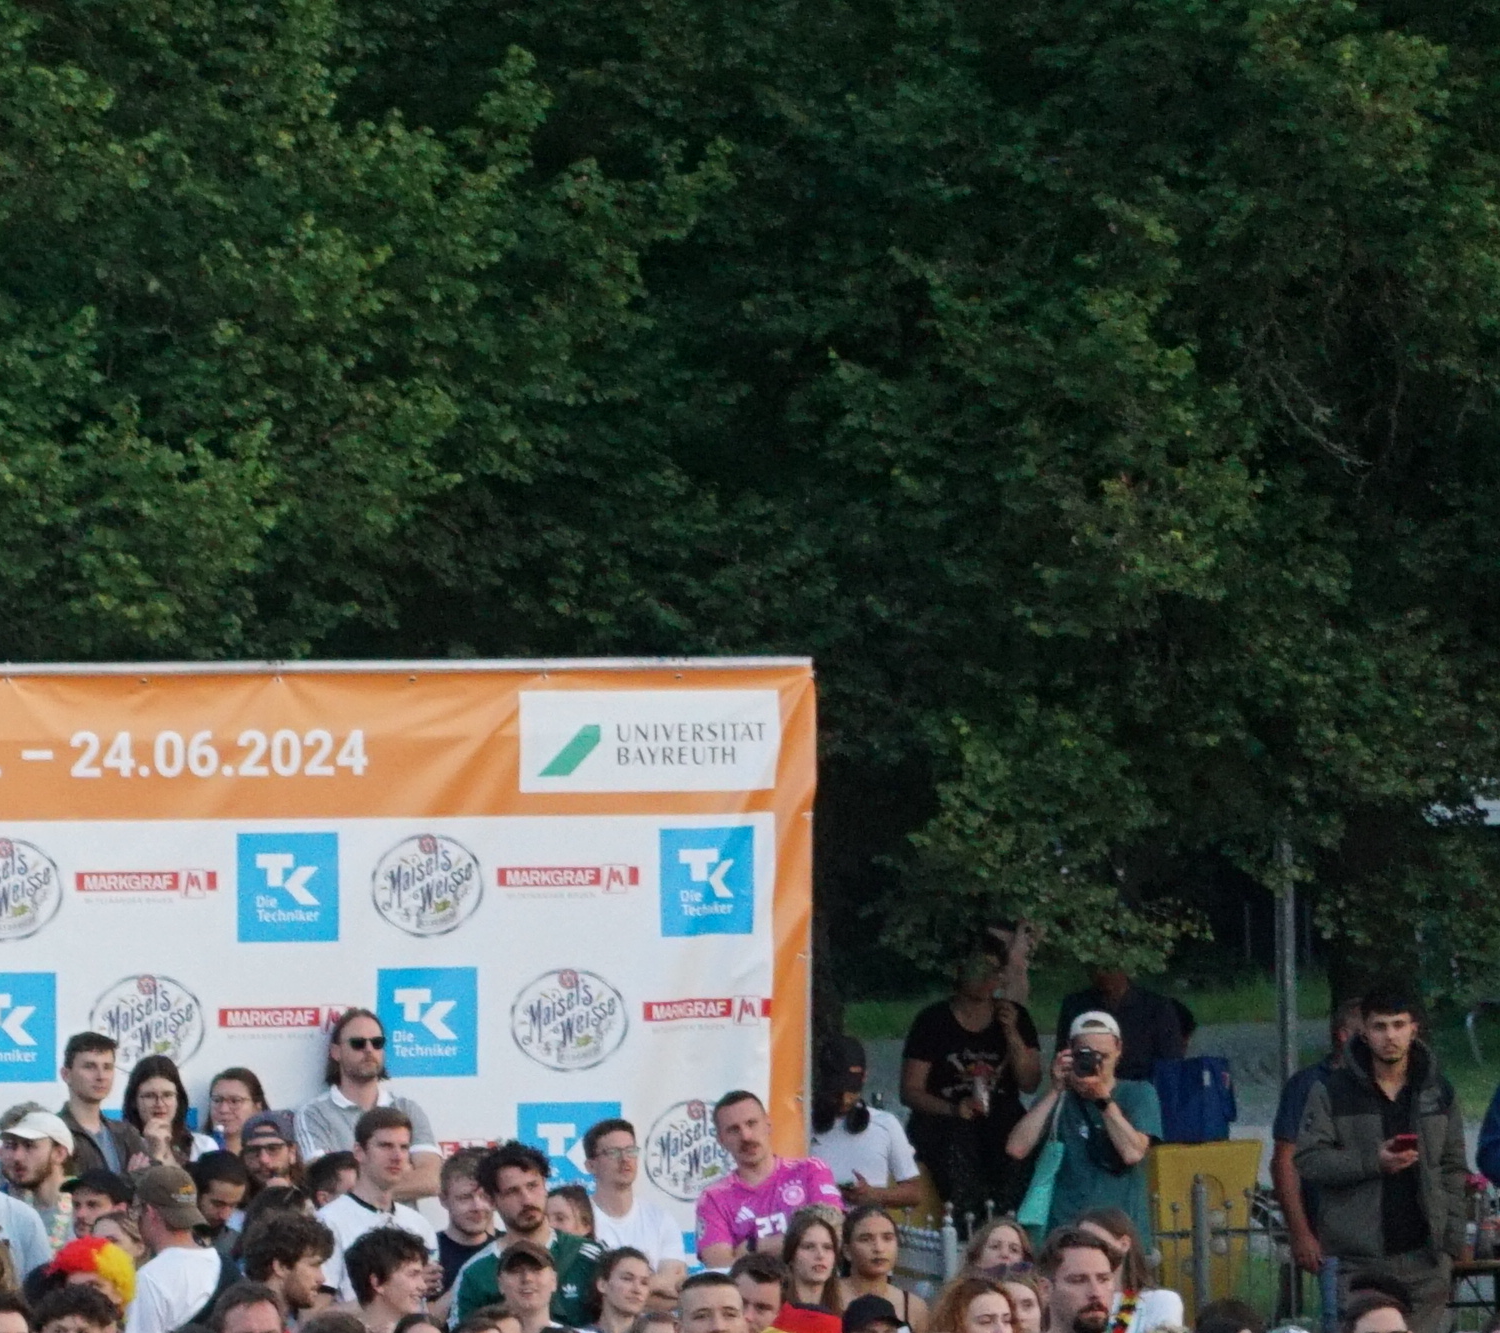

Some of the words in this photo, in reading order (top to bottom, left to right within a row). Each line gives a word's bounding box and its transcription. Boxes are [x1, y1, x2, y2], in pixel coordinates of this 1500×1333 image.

[616, 721, 767, 744] UNIVERSITÄT
[69, 728, 369, 778] 24.06.2024
[617, 746, 737, 766] BAYREUTH
[256, 853, 321, 905] TK
[505, 869, 596, 886] MARKGRAF
[678, 848, 733, 899] TK
[83, 874, 173, 891] MARKGRAF
[256, 895, 278, 908] Die
[680, 890, 702, 904] Die
[257, 909, 321, 923] Techniker
[682, 903, 734, 917] Techniker
[226, 1010, 315, 1027] MARKGRAF
[393, 988, 457, 1040] TK
[393, 1030, 415, 1043] Die
[393, 1044, 458, 1058] Techniker
